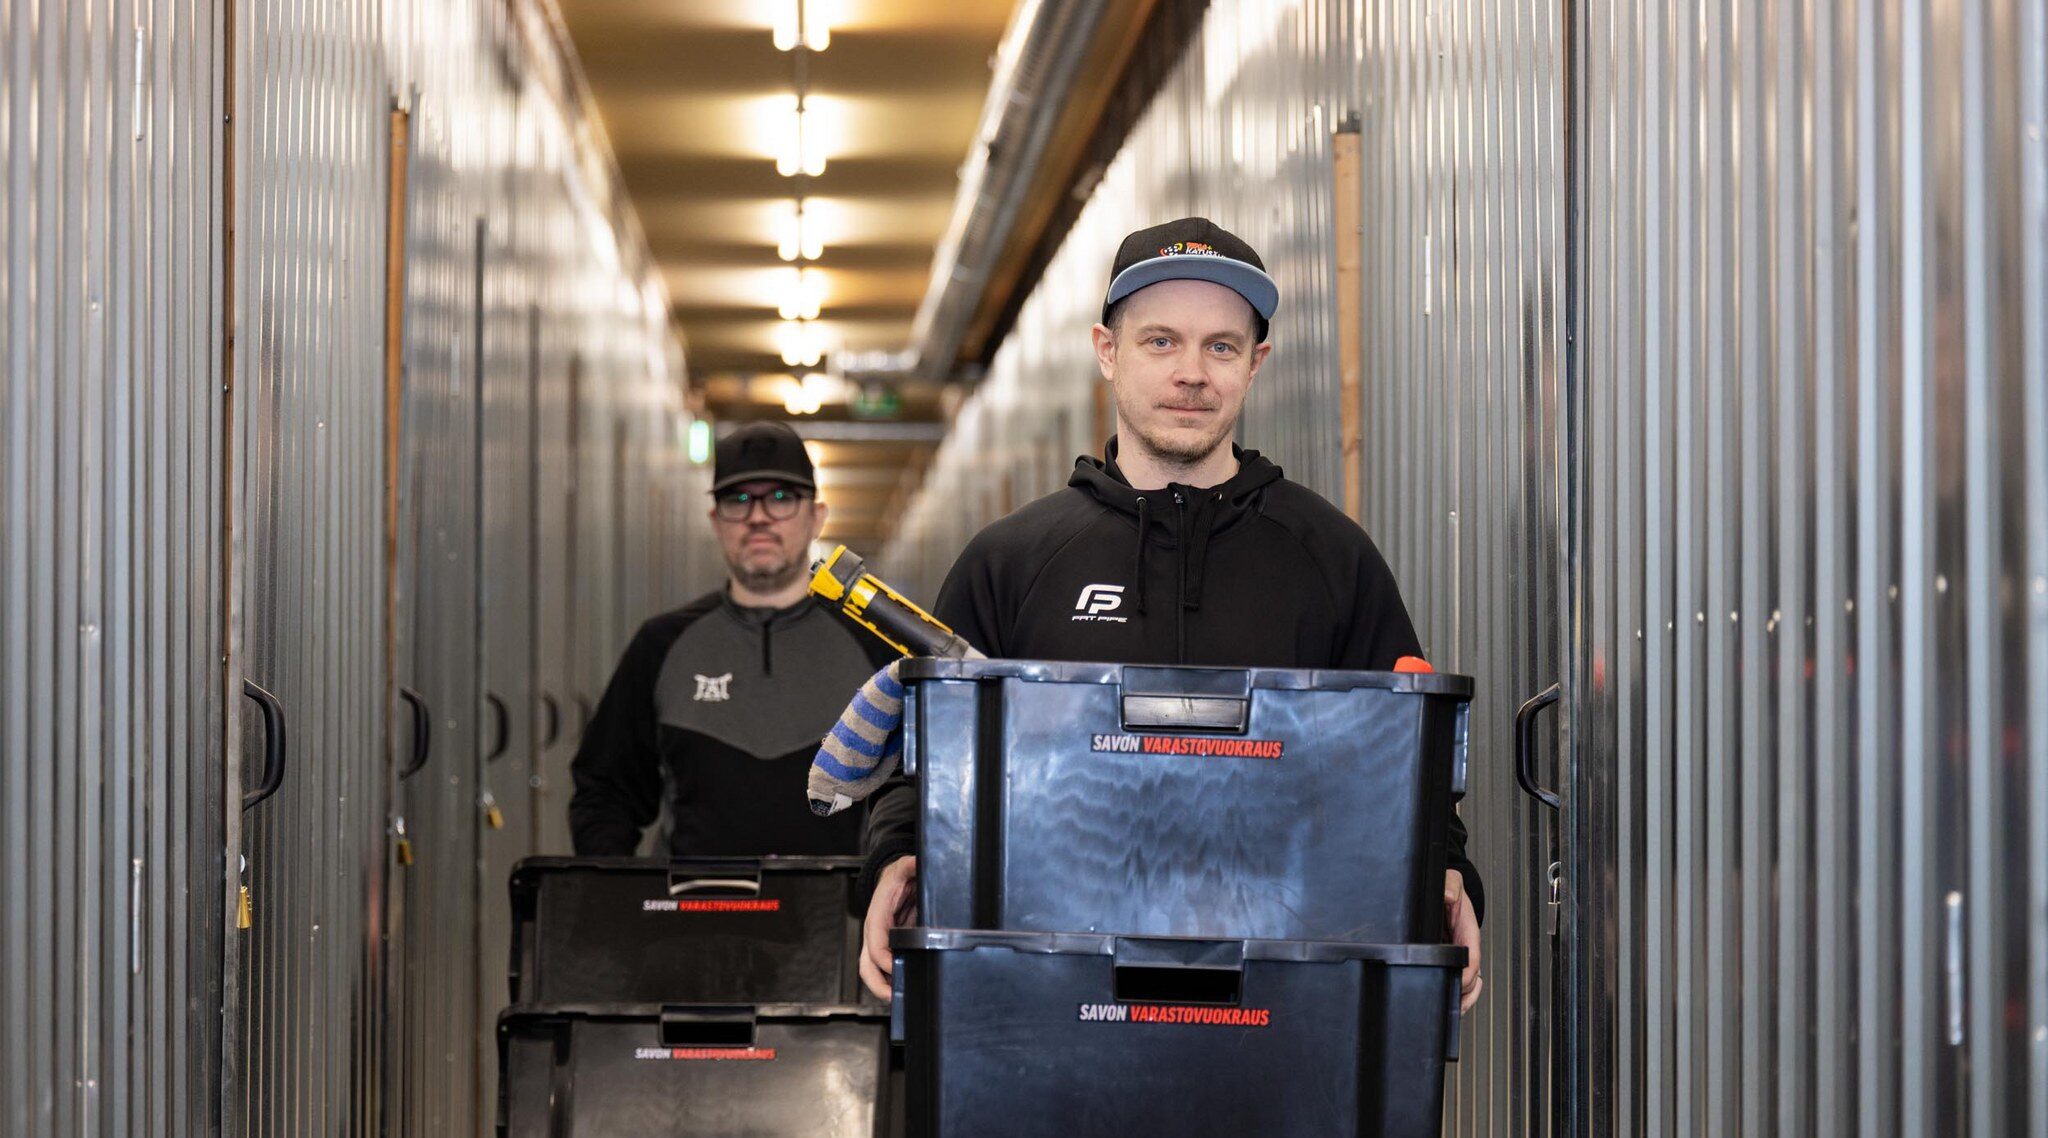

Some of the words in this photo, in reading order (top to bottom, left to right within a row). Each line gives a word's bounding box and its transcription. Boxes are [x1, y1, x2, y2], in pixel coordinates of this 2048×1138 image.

[1093, 734, 1140, 752] SAVON
[1143, 737, 1282, 758] VARASTOVUOKRAUS
[643, 900, 678, 911] SAVON
[1080, 1004, 1127, 1022] SAVON
[1130, 1006, 1270, 1026] VARASTOVUOKRAUS
[635, 1048, 671, 1059] SAVON
